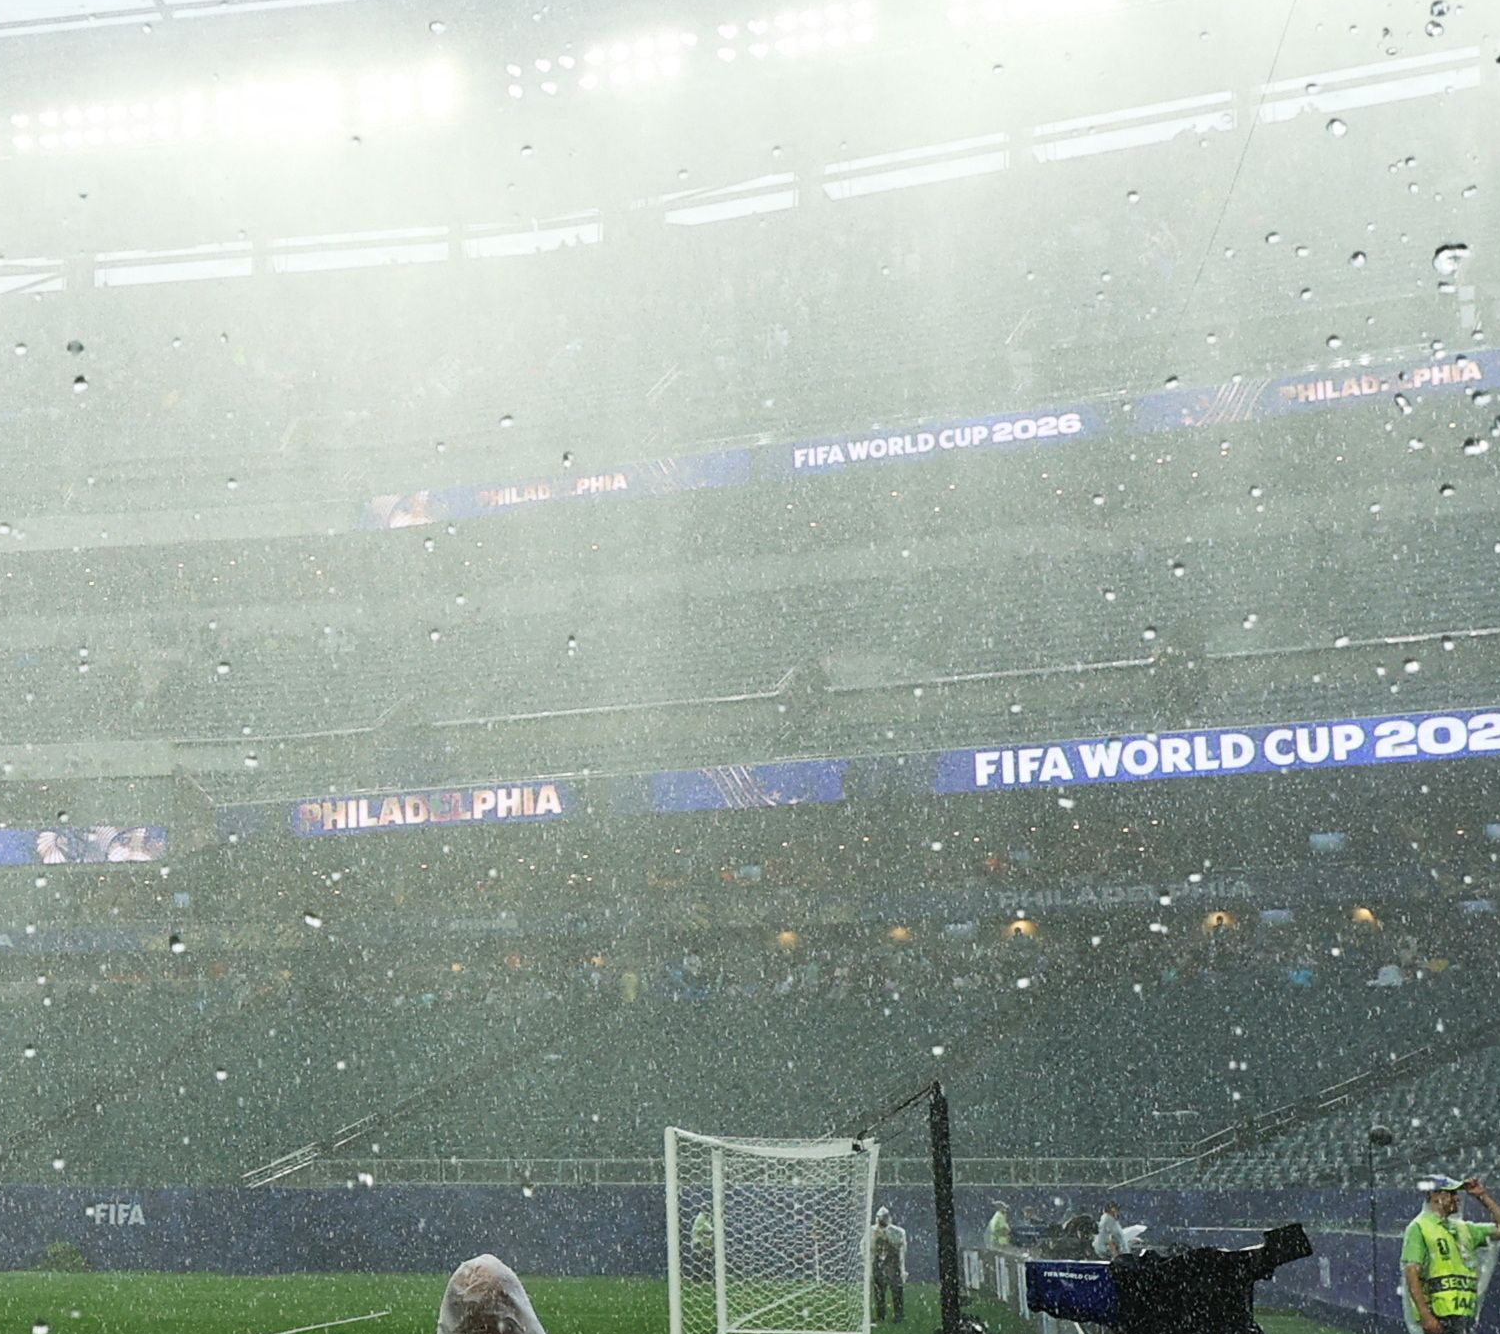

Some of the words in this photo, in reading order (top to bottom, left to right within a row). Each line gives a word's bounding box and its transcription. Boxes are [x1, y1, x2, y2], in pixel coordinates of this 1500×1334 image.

[794, 447, 844, 468] FIFA
[847, 433, 935, 462] WORLD
[939, 425, 989, 449] CUP
[992, 413, 1082, 443] 2026
[975, 748, 1073, 786] FIFA
[1079, 733, 1255, 779] WORLD
[1264, 724, 1365, 766] CUP
[95, 1203, 145, 1225] FIFA
